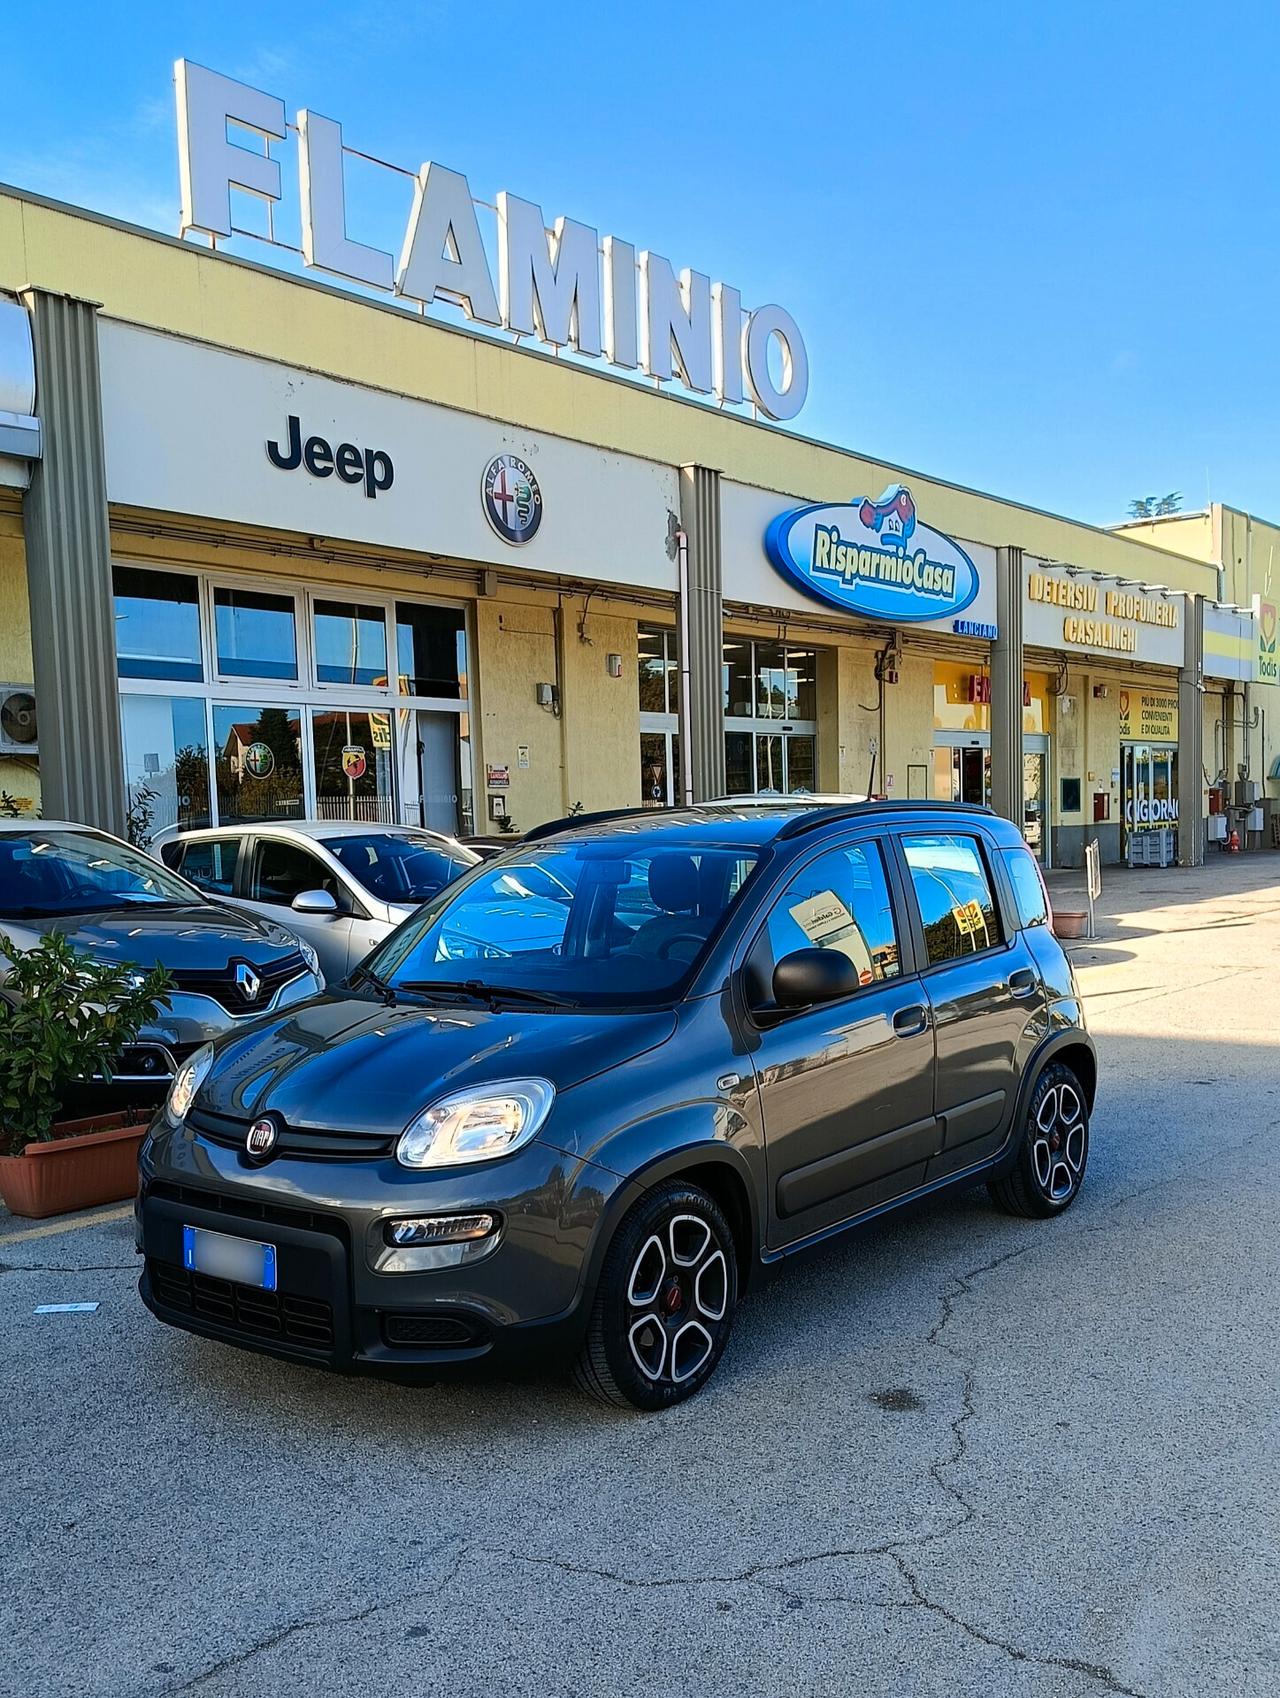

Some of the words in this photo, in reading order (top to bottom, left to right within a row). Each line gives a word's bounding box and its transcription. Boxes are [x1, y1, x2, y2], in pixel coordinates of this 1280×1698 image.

[174, 57, 809, 421] FLAMINIO
[265, 414, 395, 500] Jeep
[485, 458, 505, 497] ALFA
[509, 457, 541, 505] ROMEO
[813, 525, 955, 597] RisparmioCasa
[1106, 590, 1179, 628] PROFUMERIA
[954, 619, 998, 639] LANCIANO
[1259, 655, 1277, 678] Todis
[1141, 710, 1172, 722] CONVENIENTI
[251, 1128, 270, 1148] FIAT
